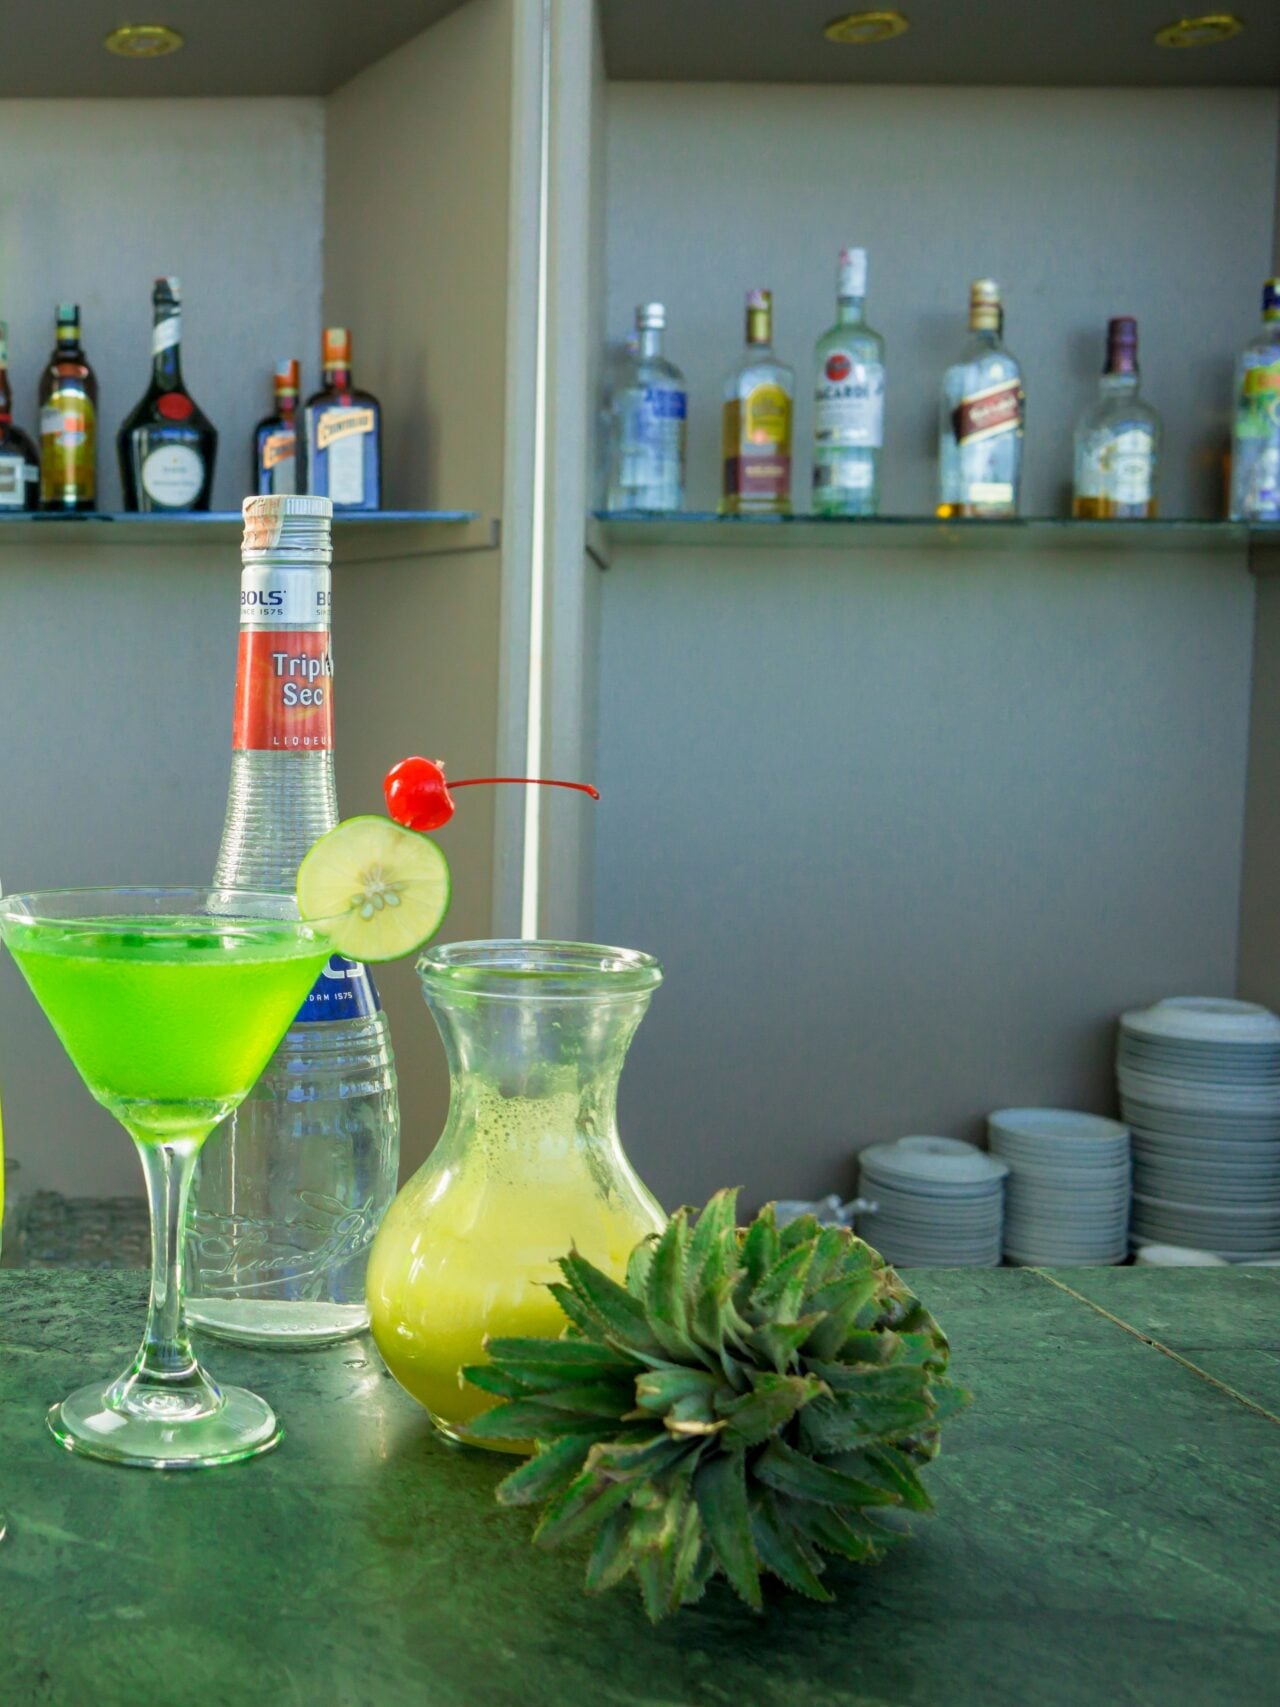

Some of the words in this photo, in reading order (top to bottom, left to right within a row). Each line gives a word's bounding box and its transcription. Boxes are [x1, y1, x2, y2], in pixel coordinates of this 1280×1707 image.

[260, 608, 283, 616] 1575
[283, 682, 323, 706] Sec
[334, 991, 353, 1001] 1575
